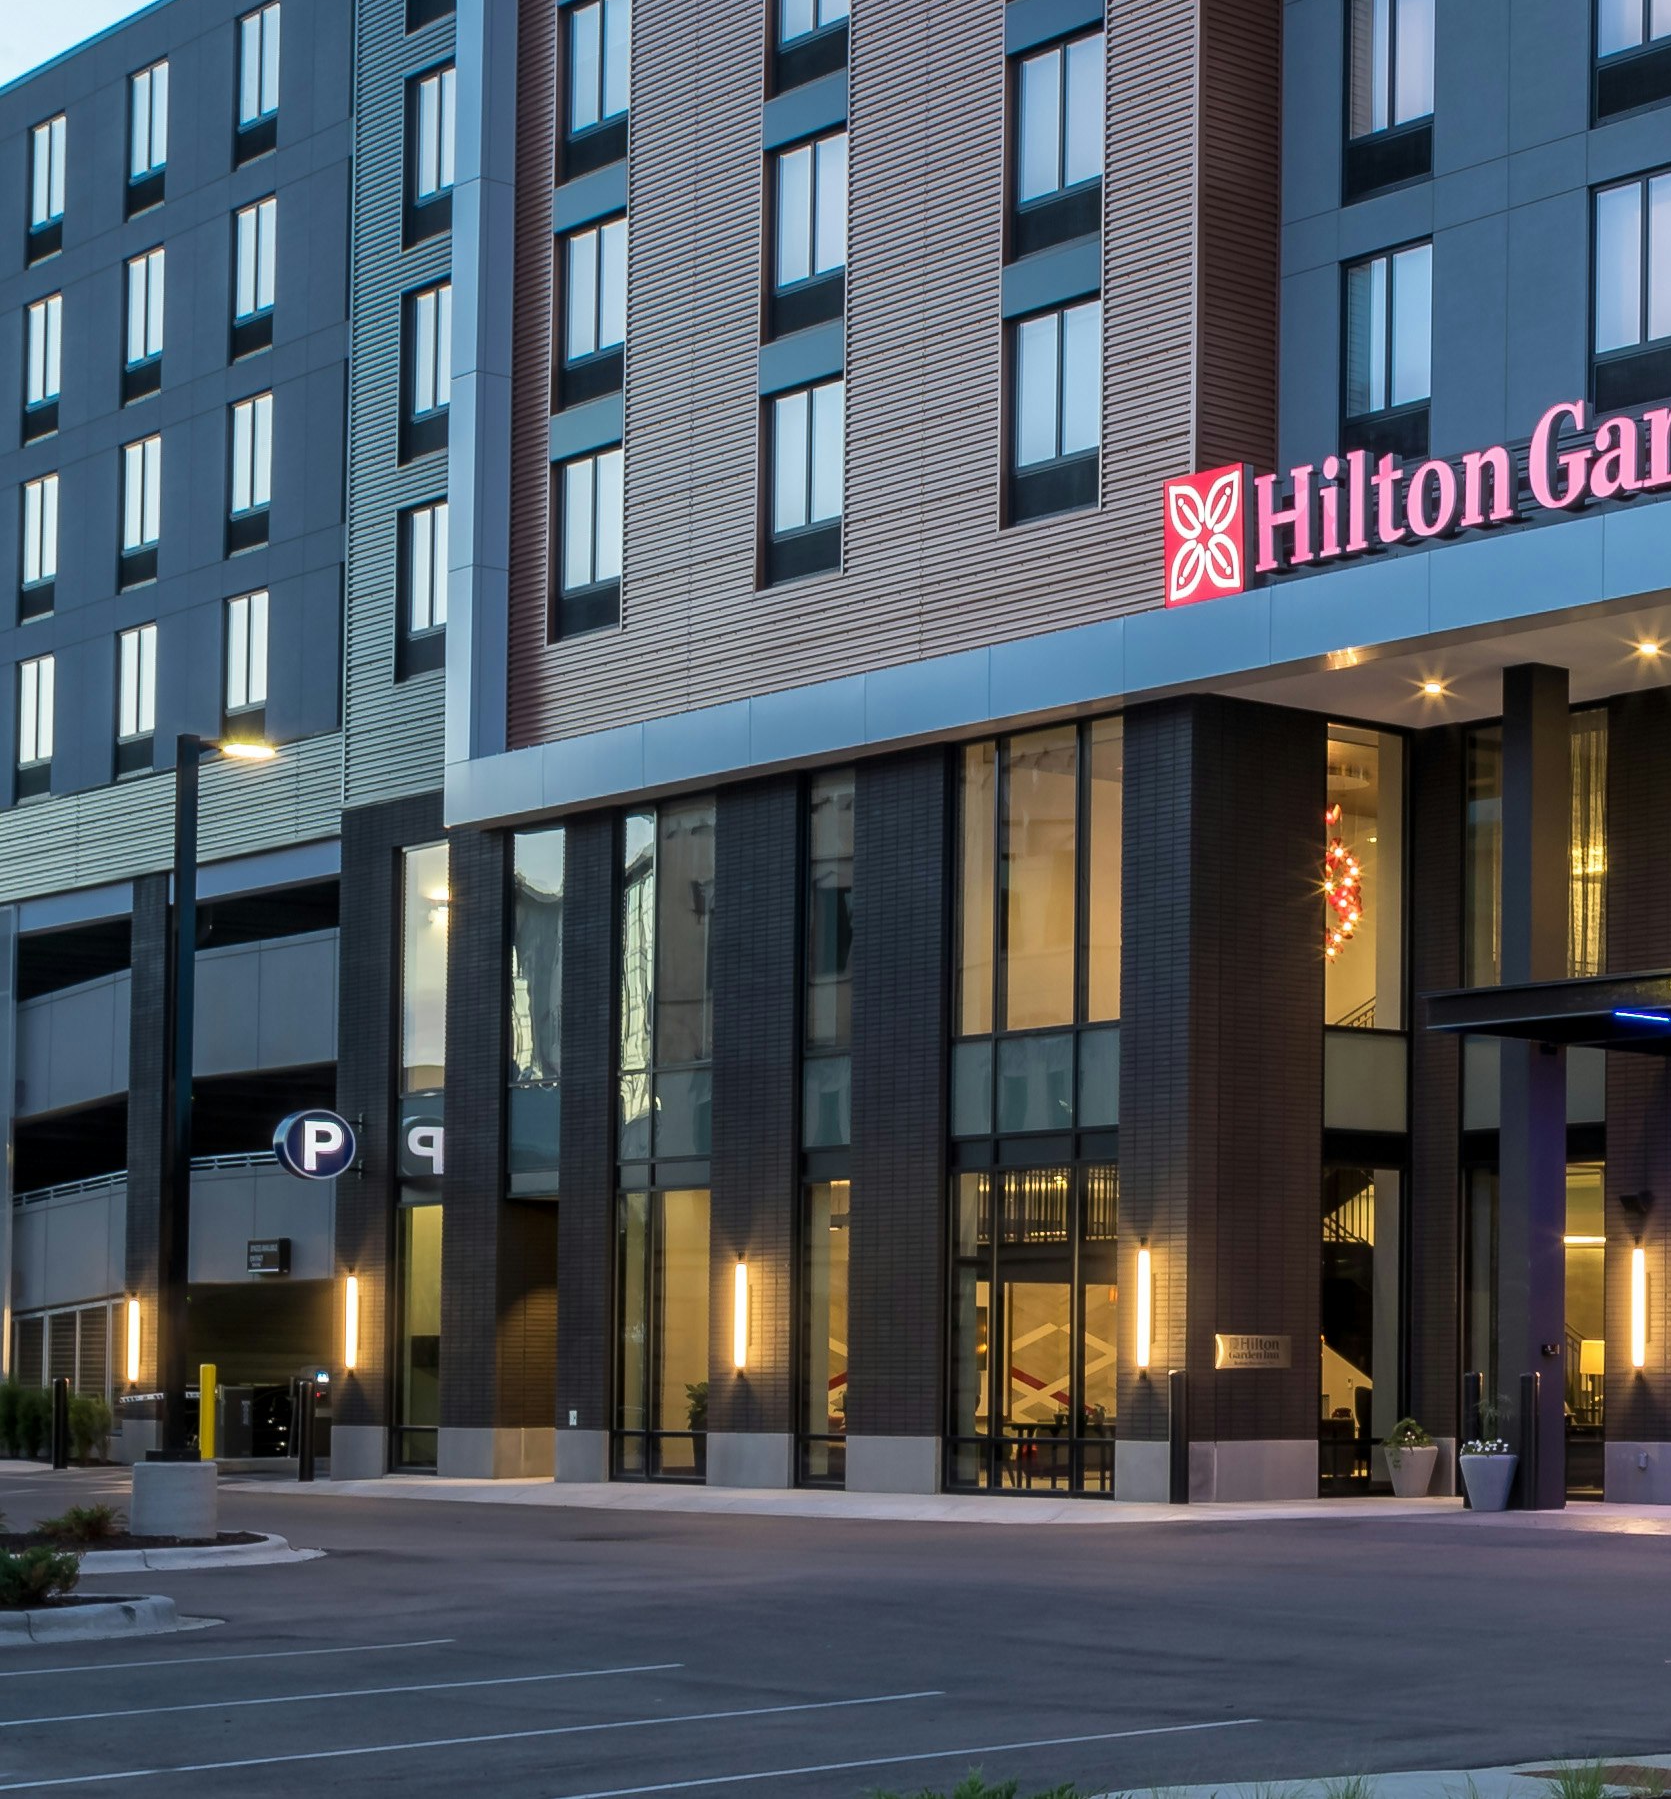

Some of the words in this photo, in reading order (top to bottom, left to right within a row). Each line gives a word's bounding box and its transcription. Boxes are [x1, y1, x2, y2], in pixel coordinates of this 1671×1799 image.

[1254, 445, 1515, 573] Hilton
[303, 1120, 343, 1171] P
[1240, 1337, 1280, 1350] Hilton
